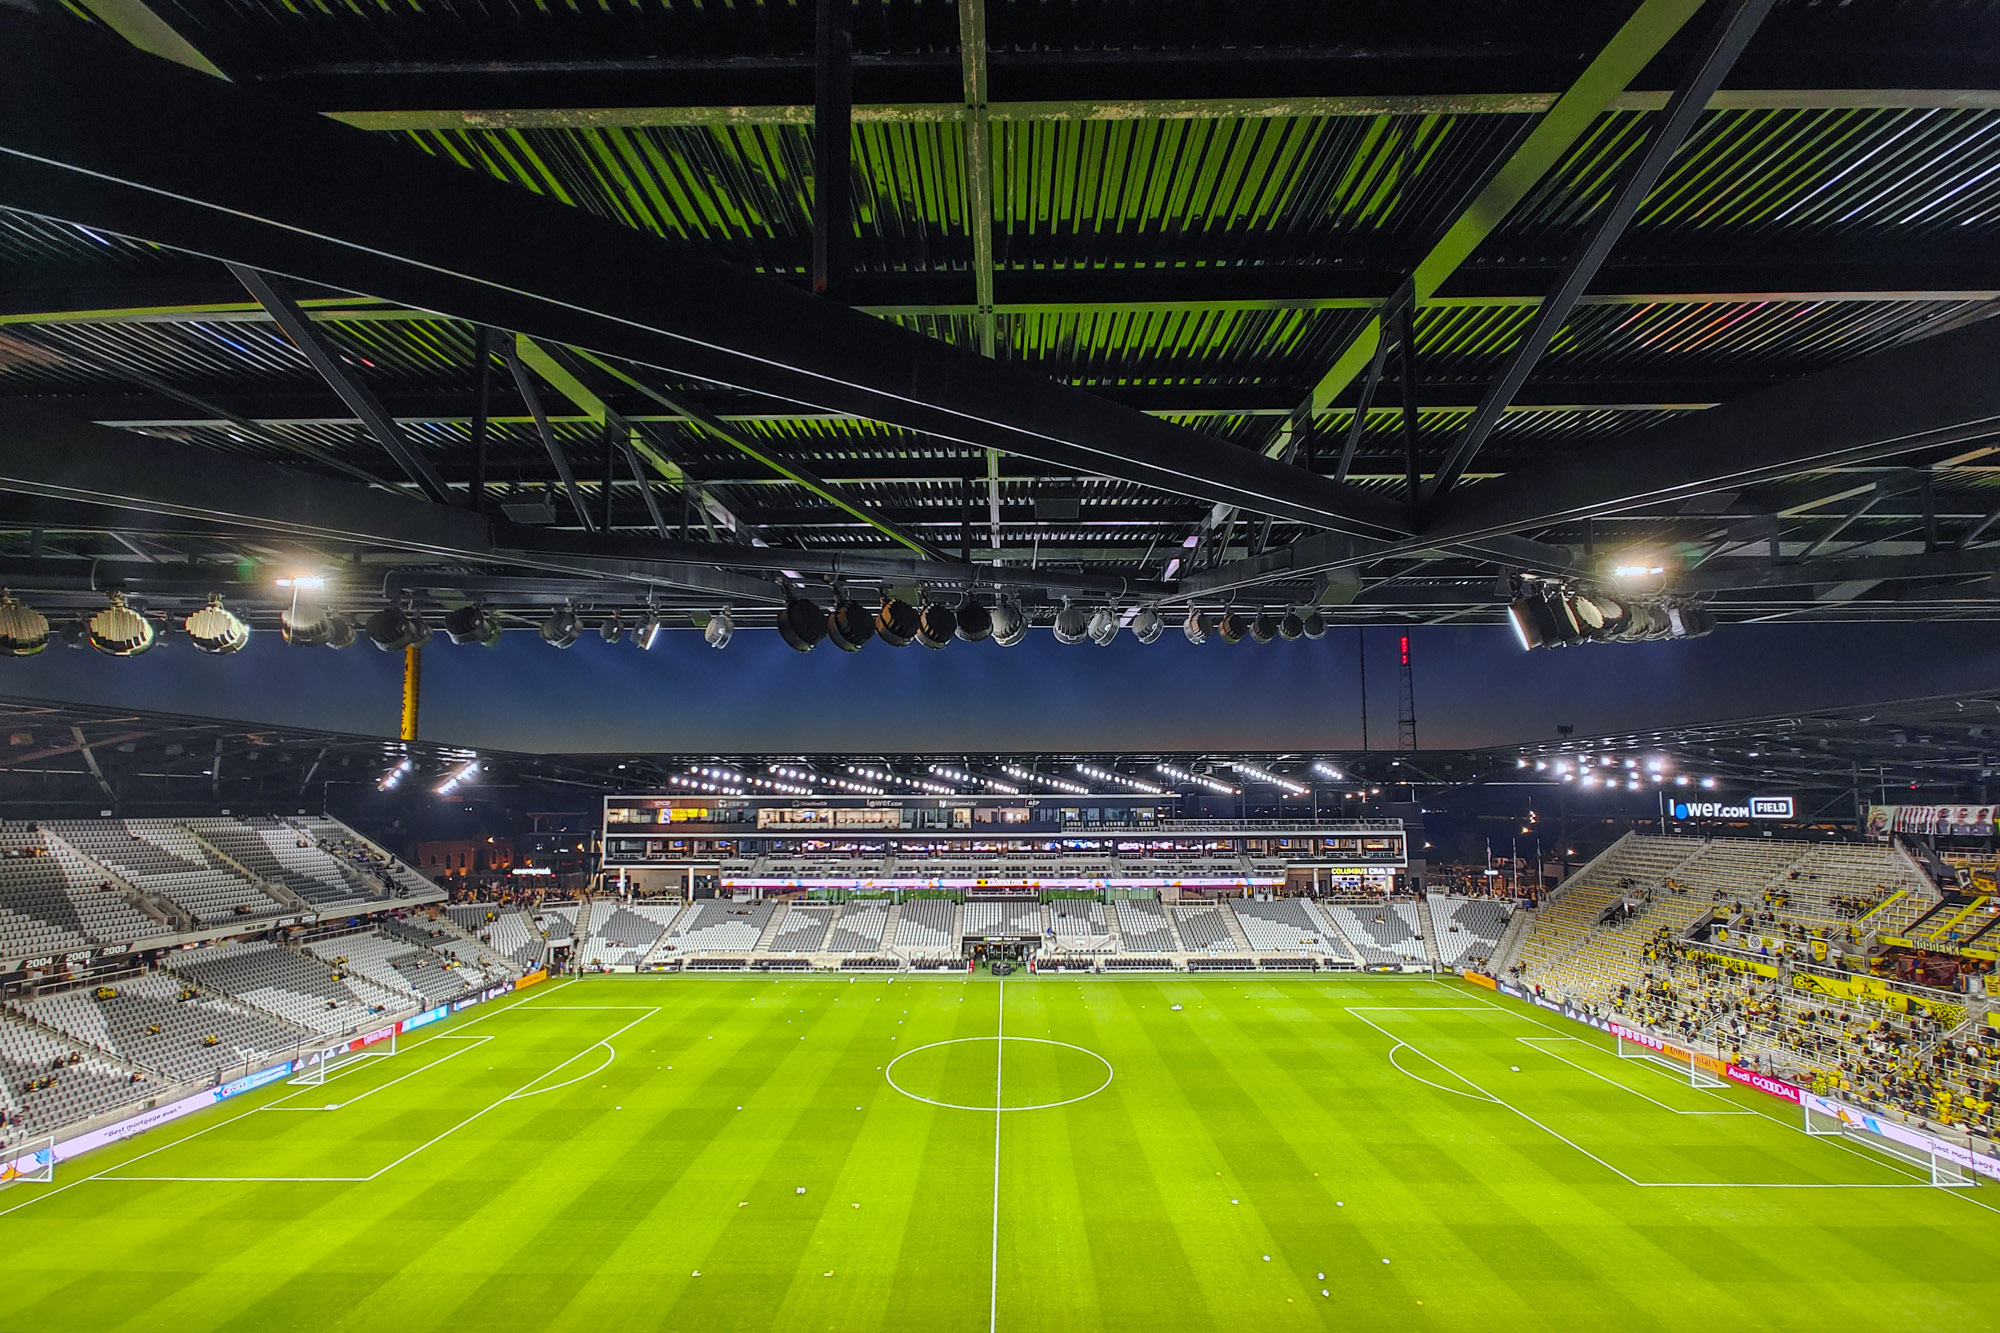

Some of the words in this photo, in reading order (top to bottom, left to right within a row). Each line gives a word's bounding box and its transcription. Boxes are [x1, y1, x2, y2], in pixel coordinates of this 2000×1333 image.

[1669, 798, 1749, 820] lower.com
[1757, 802, 1787, 813] FIELD
[65, 950, 92, 962] 2008
[102, 944, 127, 956] 2009
[25, 956, 53, 969] 2004
[1670, 1047, 1711, 1066] Continntal
[1728, 1067, 1751, 1083] Audi
[127, 1114, 161, 1130] mortgage
[1951, 1150, 1993, 1169] mortgag
